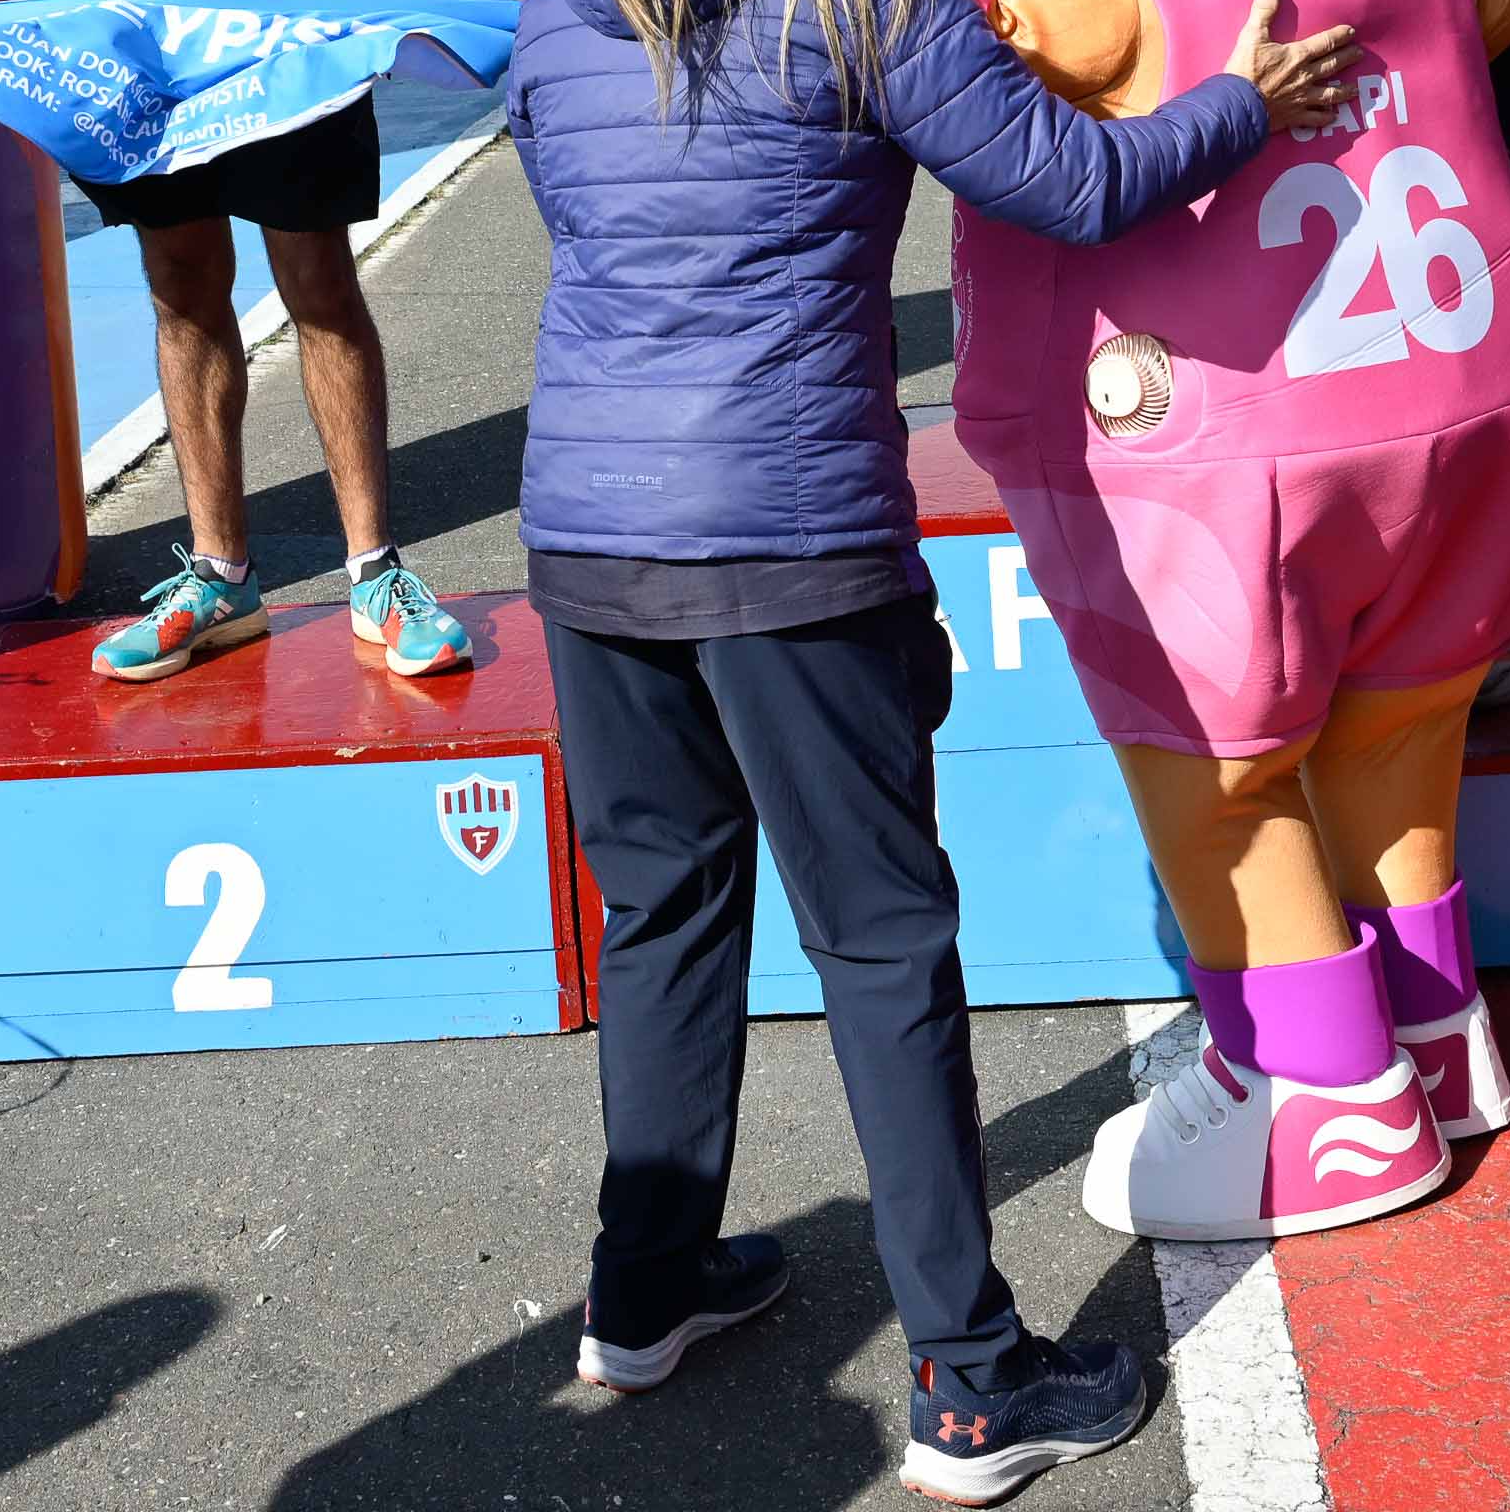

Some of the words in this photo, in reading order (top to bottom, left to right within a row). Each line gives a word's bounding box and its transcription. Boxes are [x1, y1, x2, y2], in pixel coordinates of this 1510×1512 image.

[1257, 144, 1496, 380] 26
[164, 842, 273, 1013] 2
[472, 830, 491, 854] F
